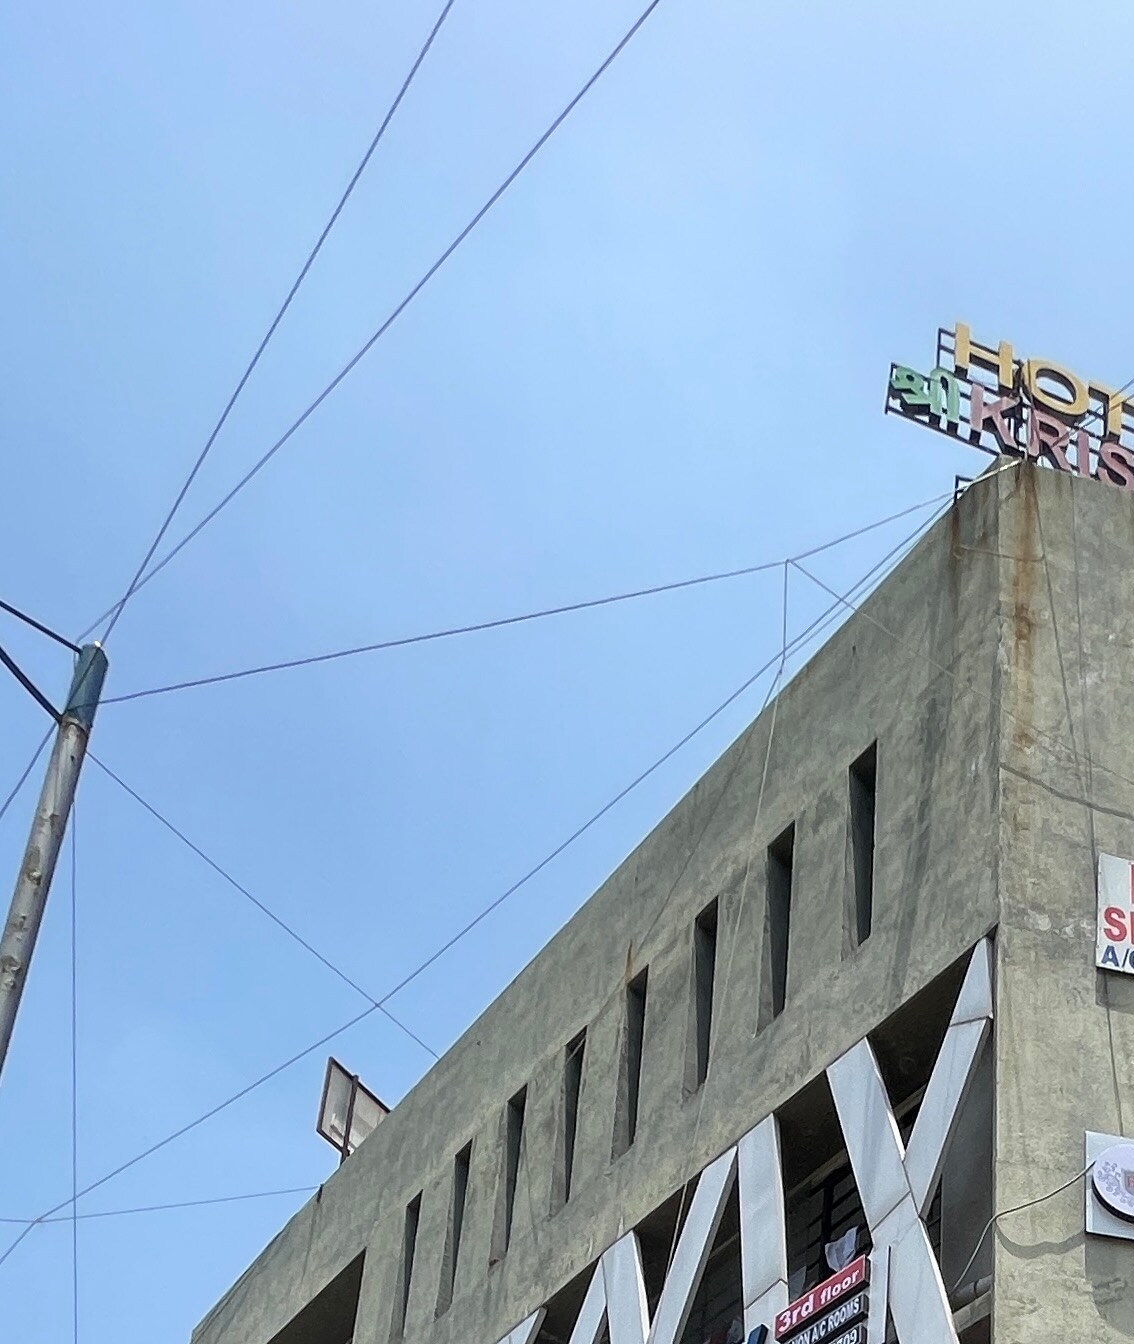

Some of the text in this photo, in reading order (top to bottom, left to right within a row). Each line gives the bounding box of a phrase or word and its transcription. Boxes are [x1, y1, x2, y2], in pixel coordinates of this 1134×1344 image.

[778, 1269, 860, 1333] 3rd floor
[827, 1298, 860, 1332] ROOMS
